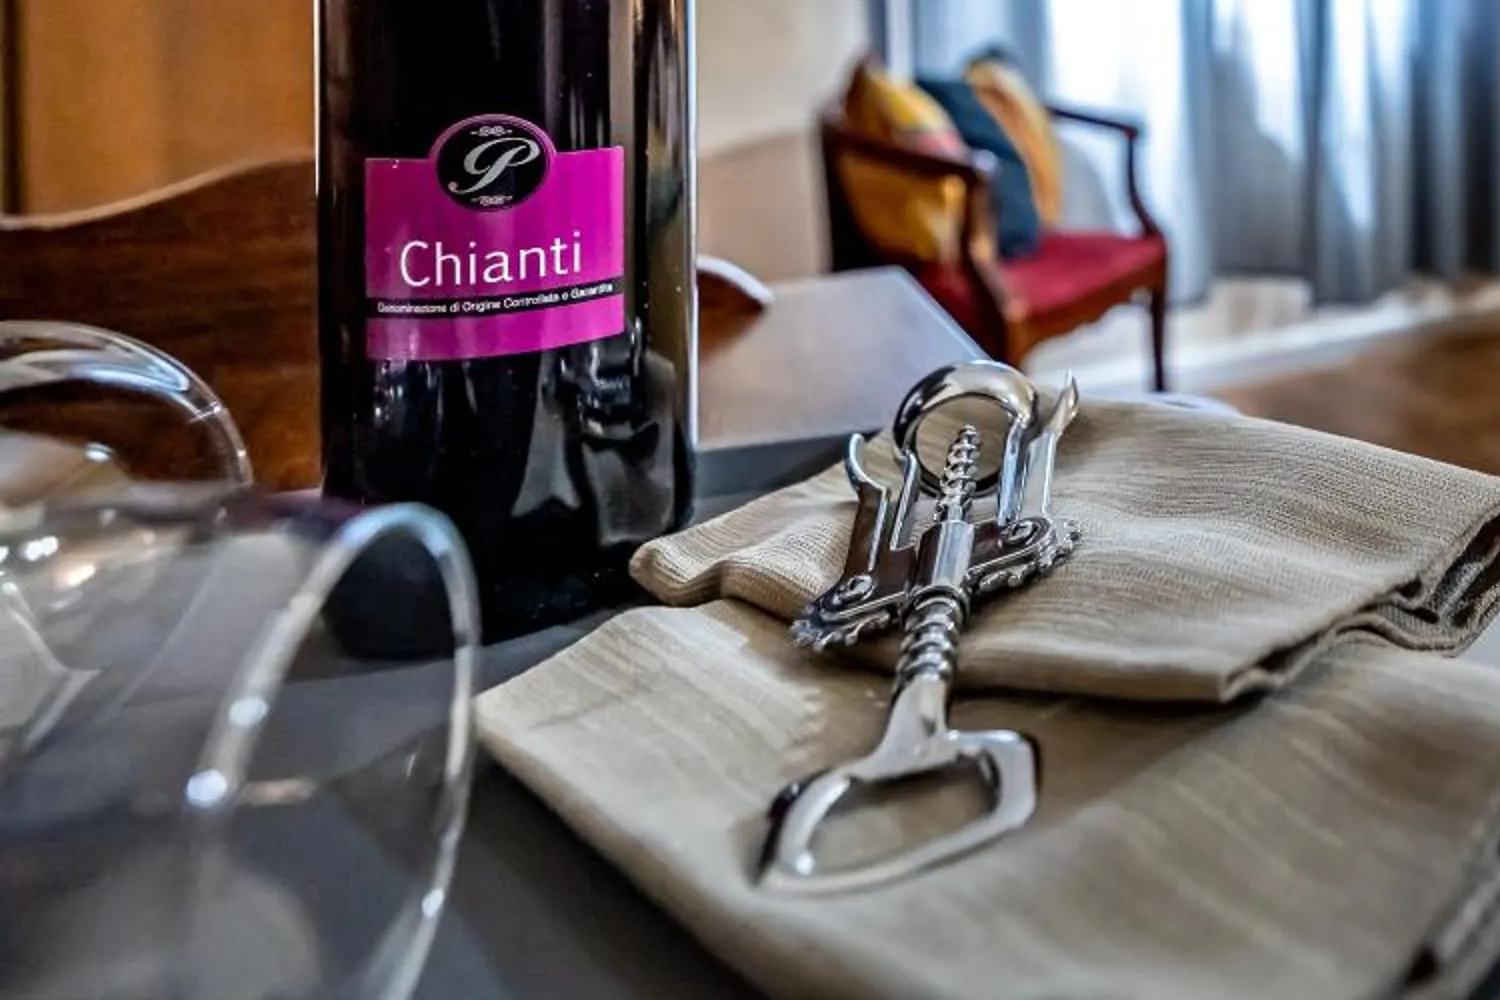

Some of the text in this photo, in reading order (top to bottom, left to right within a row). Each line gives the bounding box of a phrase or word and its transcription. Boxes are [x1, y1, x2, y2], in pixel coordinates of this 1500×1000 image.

[400, 230, 581, 287] Chianti
[449, 301, 460, 313] di
[462, 299, 501, 313] Origine
